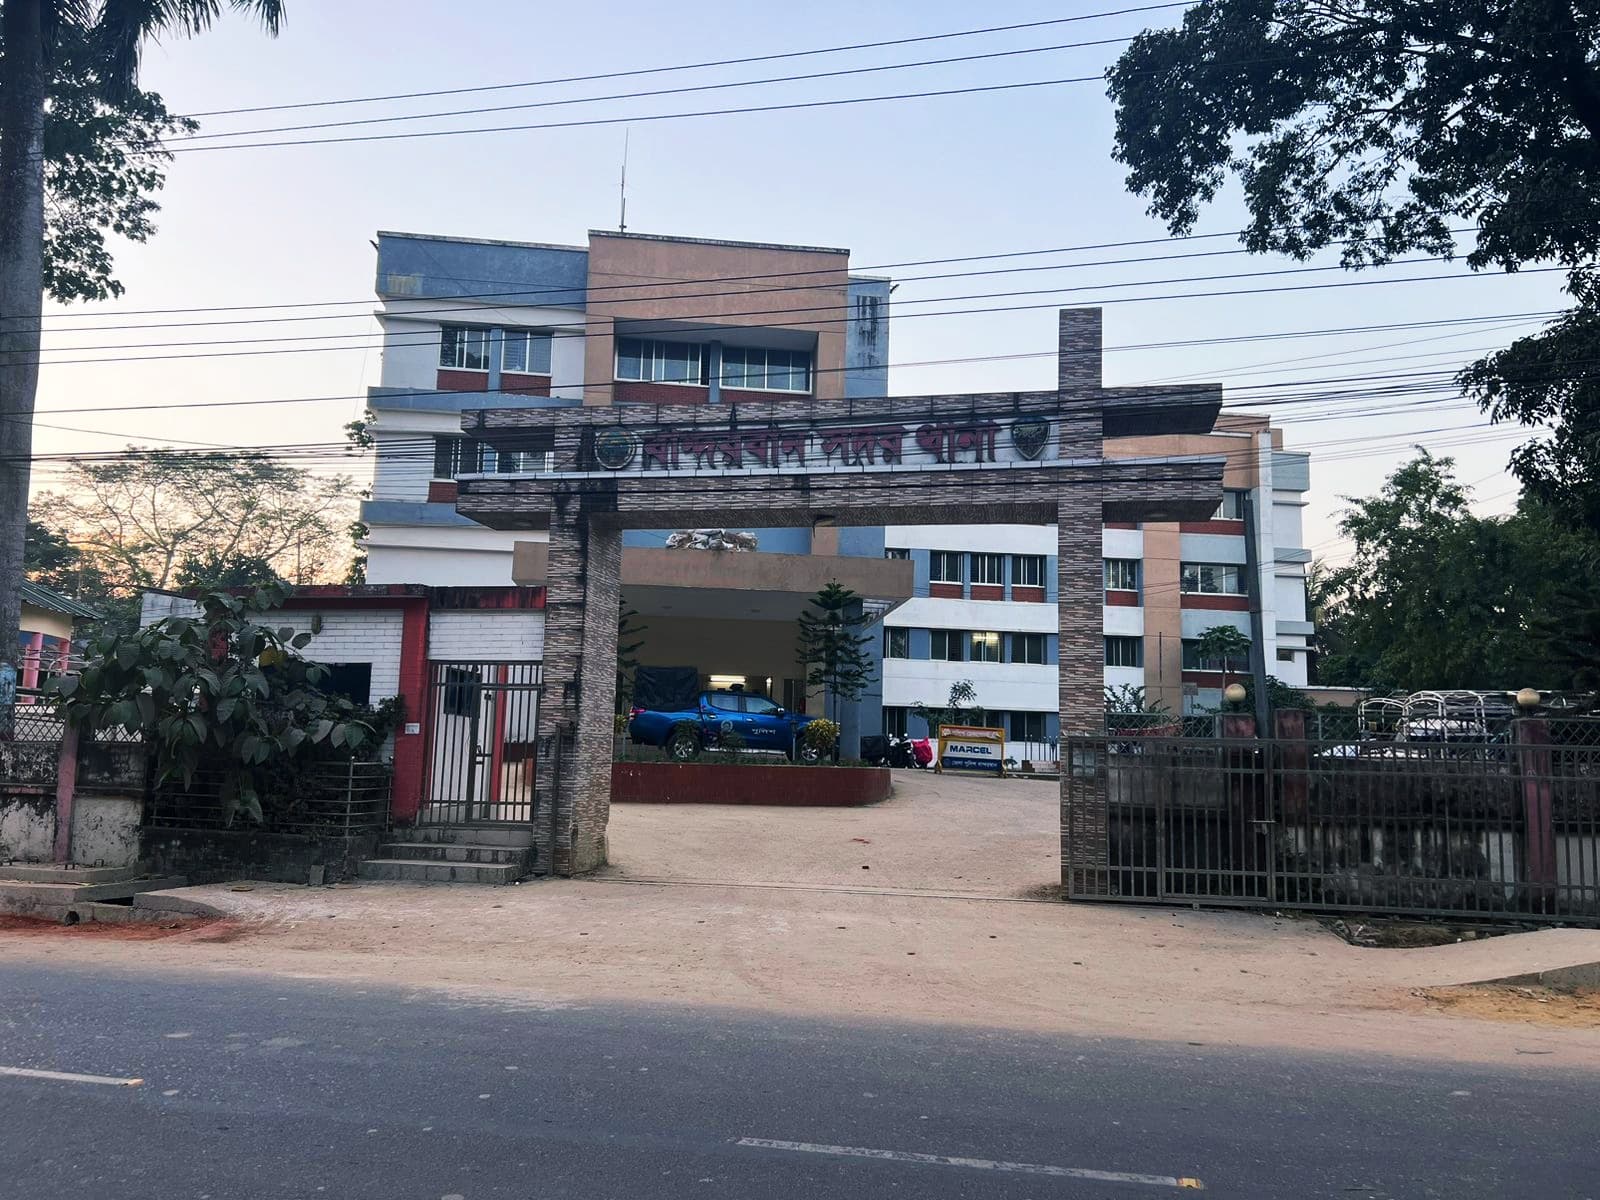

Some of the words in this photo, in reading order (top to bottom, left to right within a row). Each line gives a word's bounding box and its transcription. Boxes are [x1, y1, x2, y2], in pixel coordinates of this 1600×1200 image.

[643, 430, 806, 470] বান্দরবান
[816, 425, 907, 465] সদর
[916, 420, 1001, 463] থানা
[949, 745, 992, 755] MARCEL
